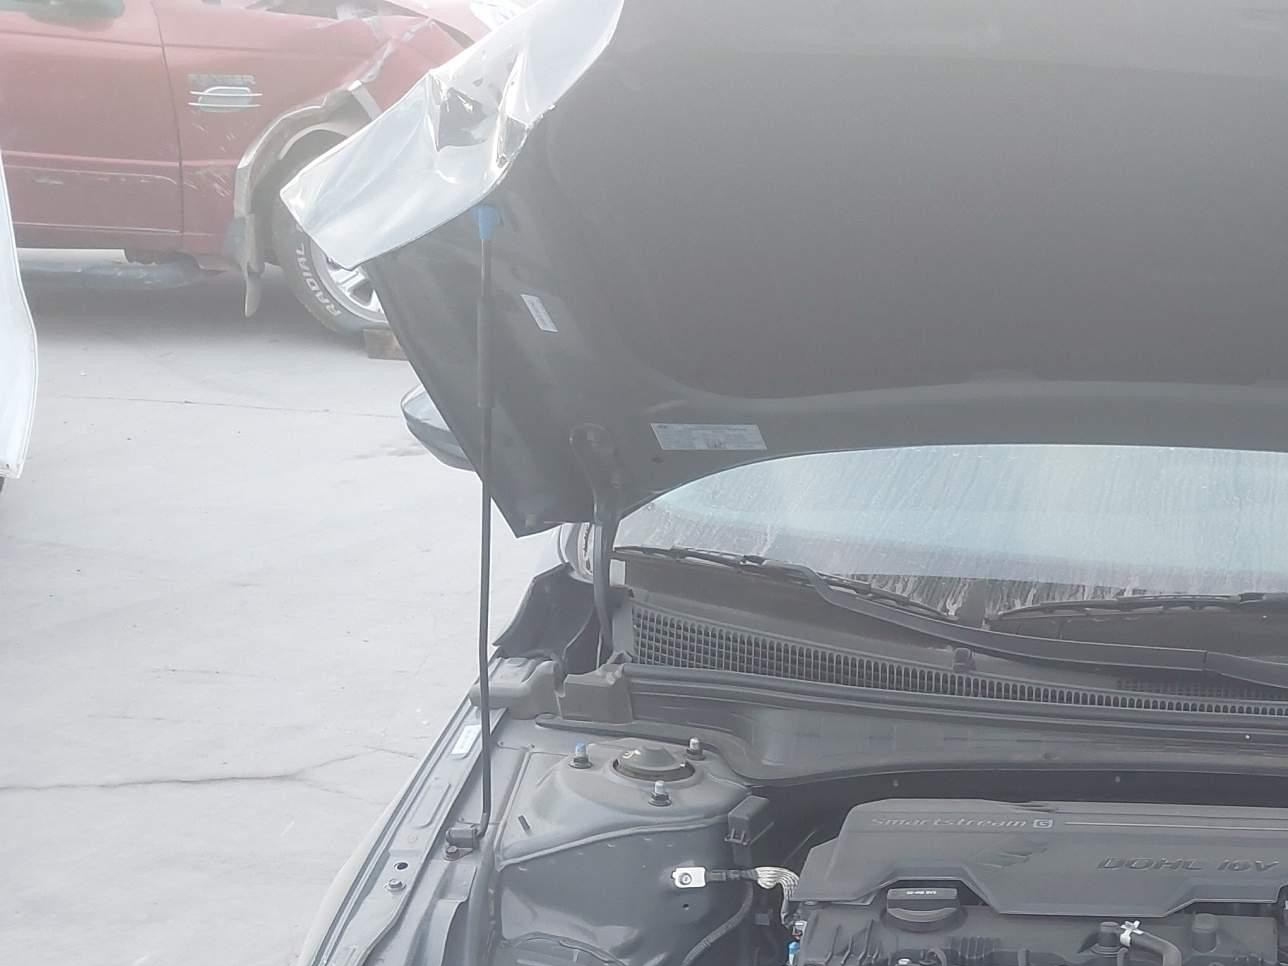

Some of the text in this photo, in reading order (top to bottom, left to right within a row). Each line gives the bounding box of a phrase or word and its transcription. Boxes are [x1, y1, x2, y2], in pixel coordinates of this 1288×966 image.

[295, 242, 342, 317] RADIAL
[871, 816, 1027, 829] Smartstream
[1216, 858, 1281, 873] 16V
